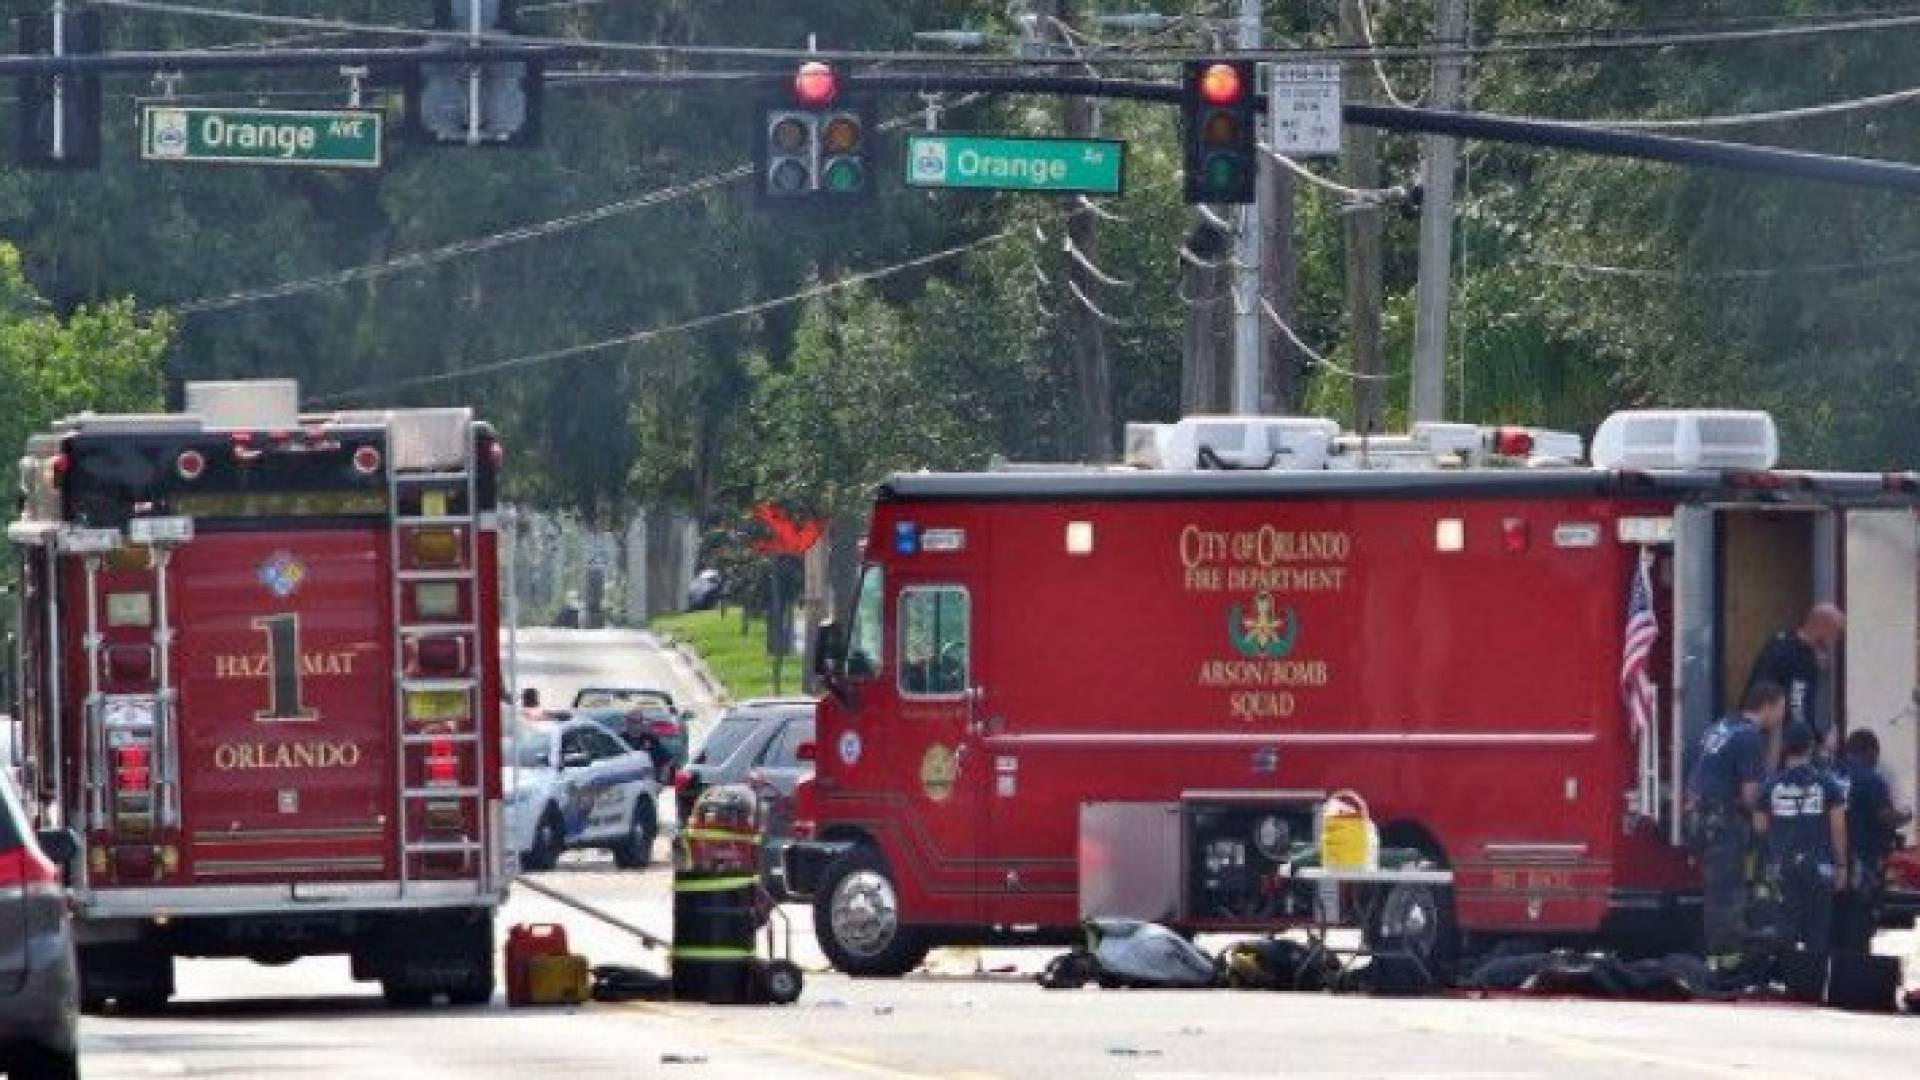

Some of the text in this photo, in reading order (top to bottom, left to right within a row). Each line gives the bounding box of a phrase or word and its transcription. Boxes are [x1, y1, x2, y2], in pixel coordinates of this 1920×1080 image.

[202, 115, 315, 157] Orange
[327, 119, 363, 138] AVE
[957, 149, 1067, 185] Orange
[1231, 531, 1258, 560] OF
[1258, 524, 1350, 565] ORLANDO
[1185, 566, 1346, 591] FIRE DEPARTMENT
[215, 652, 356, 678] HAZ MAT
[251, 612, 319, 722] 1
[1230, 690, 1295, 721] SQUAD
[216, 744, 360, 768] ORLANDO
